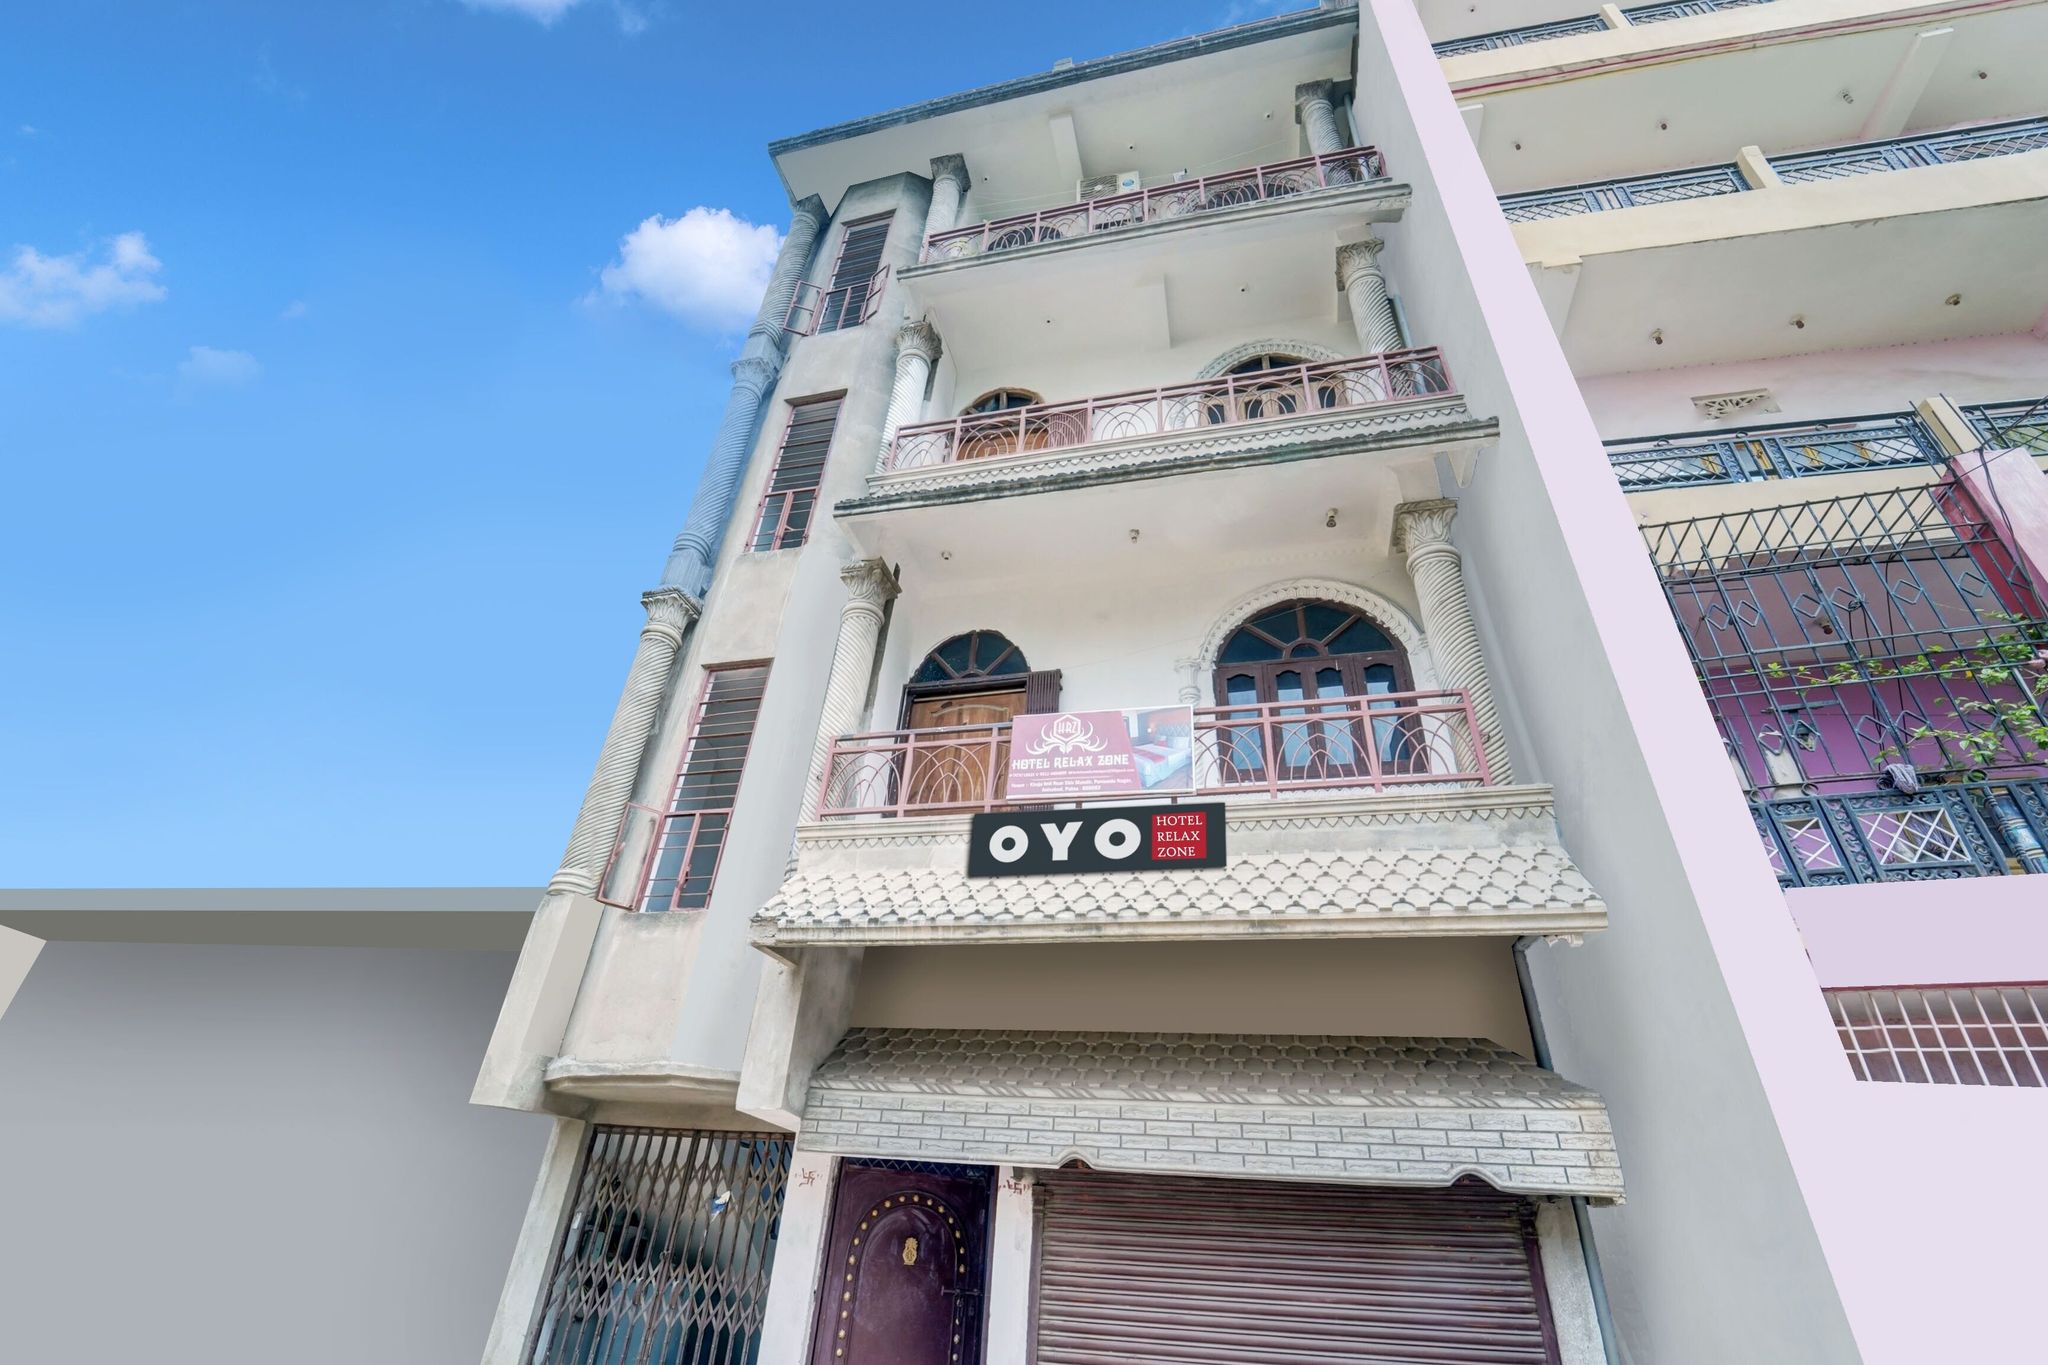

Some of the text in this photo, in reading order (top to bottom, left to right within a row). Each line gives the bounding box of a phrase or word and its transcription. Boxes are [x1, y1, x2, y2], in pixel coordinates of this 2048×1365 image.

[1012, 754, 1129, 770] HOTEL RELAX ZONE
[1156, 815, 1203, 827] HOTEL
[989, 818, 1142, 863] OYO
[1157, 830, 1201, 842] RELAX
[1157, 847, 1196, 858] ZONE
